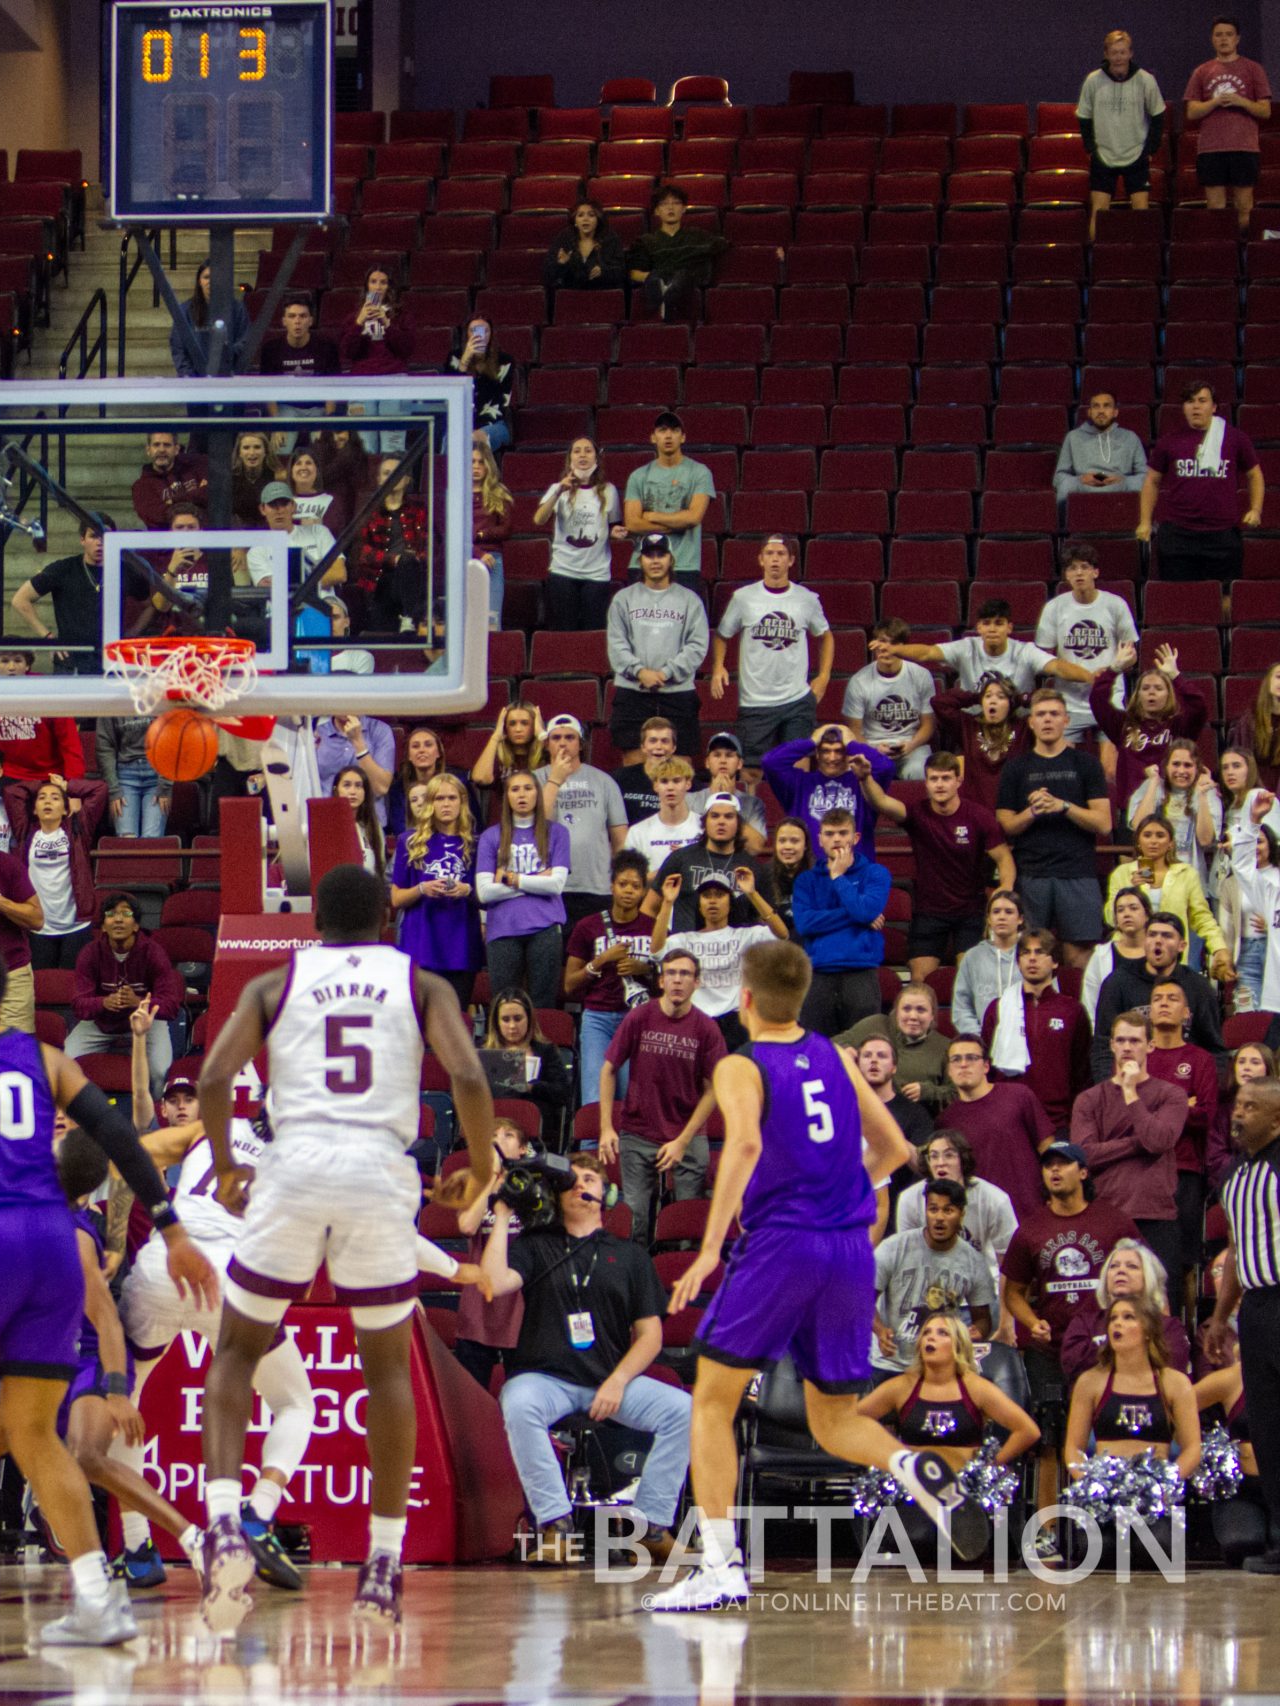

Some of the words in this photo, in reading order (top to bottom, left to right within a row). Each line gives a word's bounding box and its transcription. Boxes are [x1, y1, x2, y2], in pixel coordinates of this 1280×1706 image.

[169, 6, 272, 18] DAKTRONICS
[629, 608, 663, 621] TEXAS
[664, 610, 687, 624] A&M
[763, 618, 792, 629] REED
[751, 626, 800, 640] ROWDIES
[1074, 627, 1102, 637] REED
[1064, 636, 1110, 647] ROWDIES
[880, 703, 908, 713] REED
[871, 711, 919, 721] ROWDIES
[624, 793, 644, 801] AGGIE
[312, 983, 388, 1005] DIARRA
[325, 1014, 373, 1094] 5
[802, 1079, 835, 1143] 5
[1039, 1231, 1077, 1270] TEXAS
[1078, 1233, 1105, 1264] A&M
[1052, 1281, 1095, 1291] FOOTBALL
